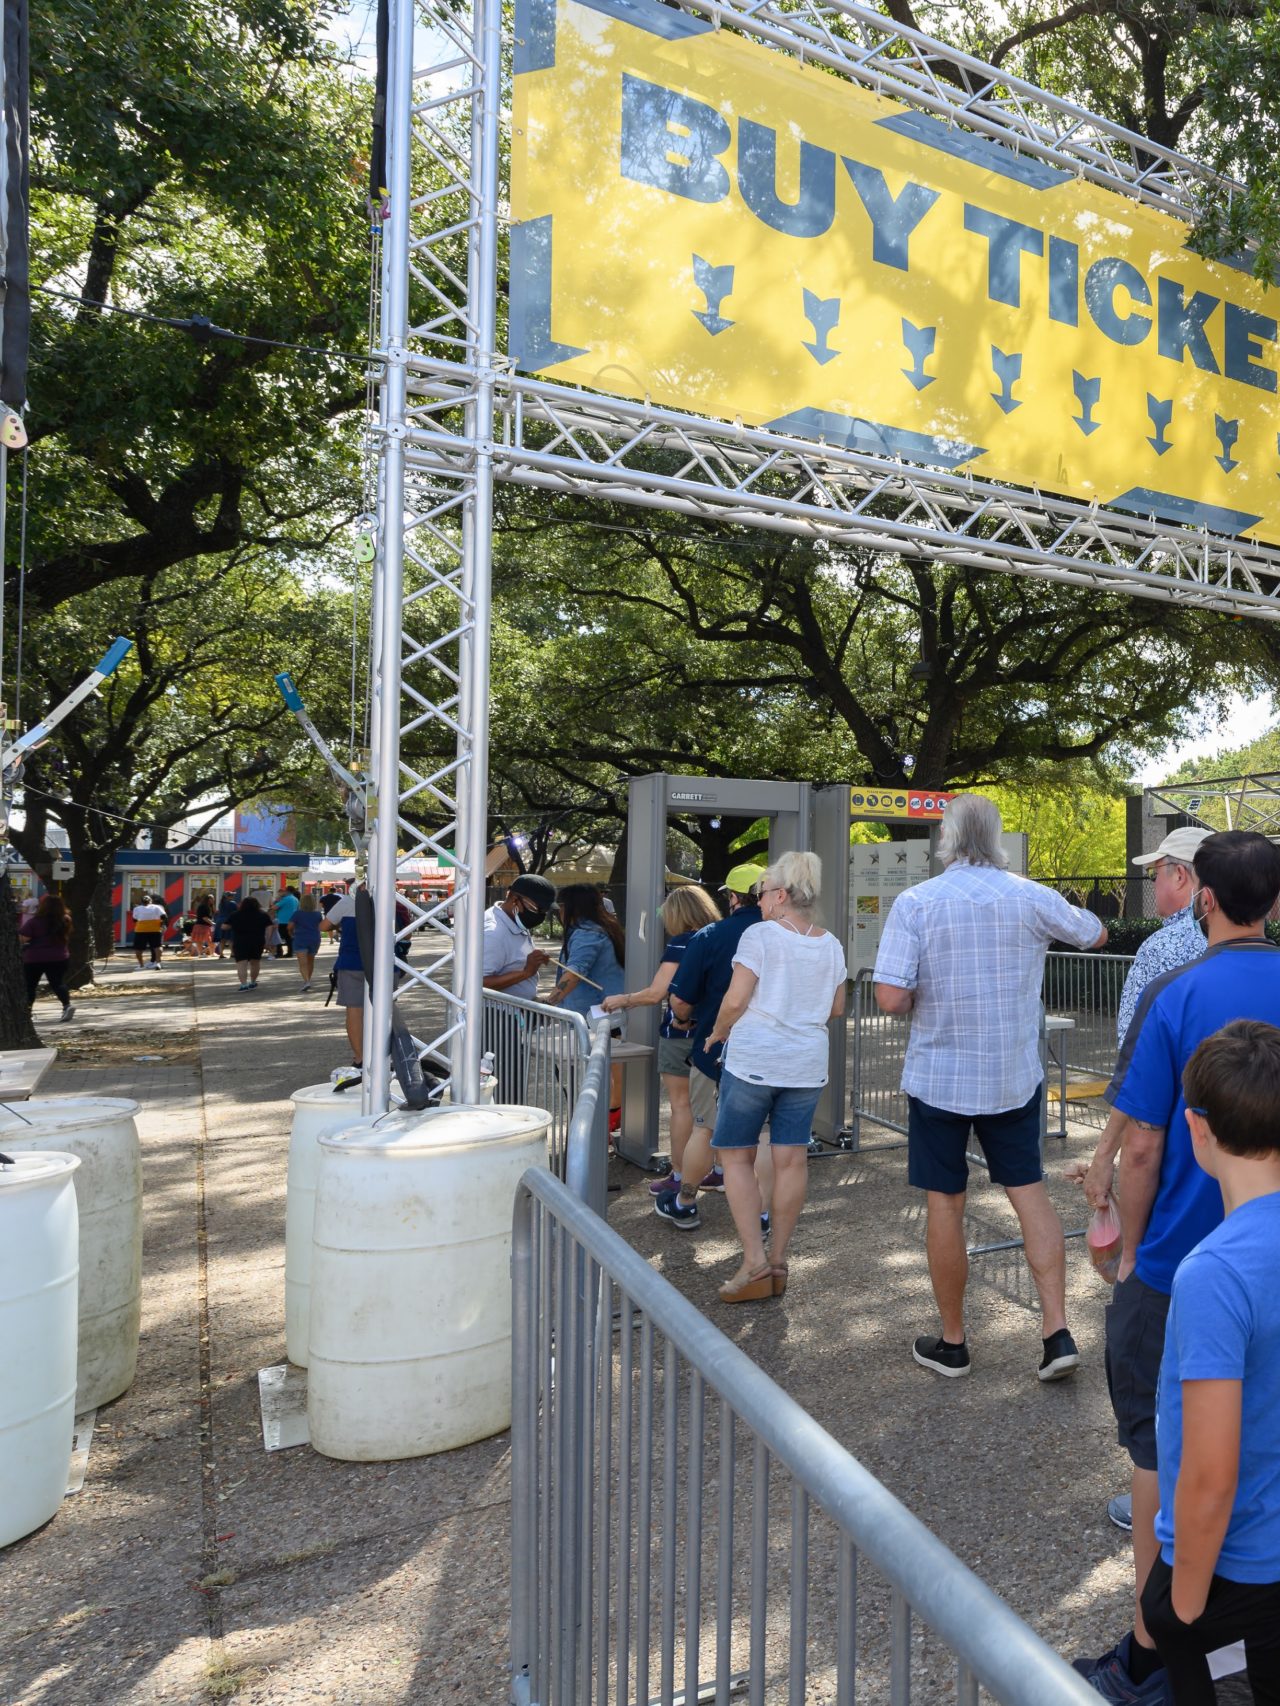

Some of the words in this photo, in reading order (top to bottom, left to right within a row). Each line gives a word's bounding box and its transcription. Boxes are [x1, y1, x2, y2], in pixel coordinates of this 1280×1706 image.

[621, 71, 940, 271] BUY
[671, 792, 702, 800] GARRETT
[170, 853, 243, 866] TICKETS
